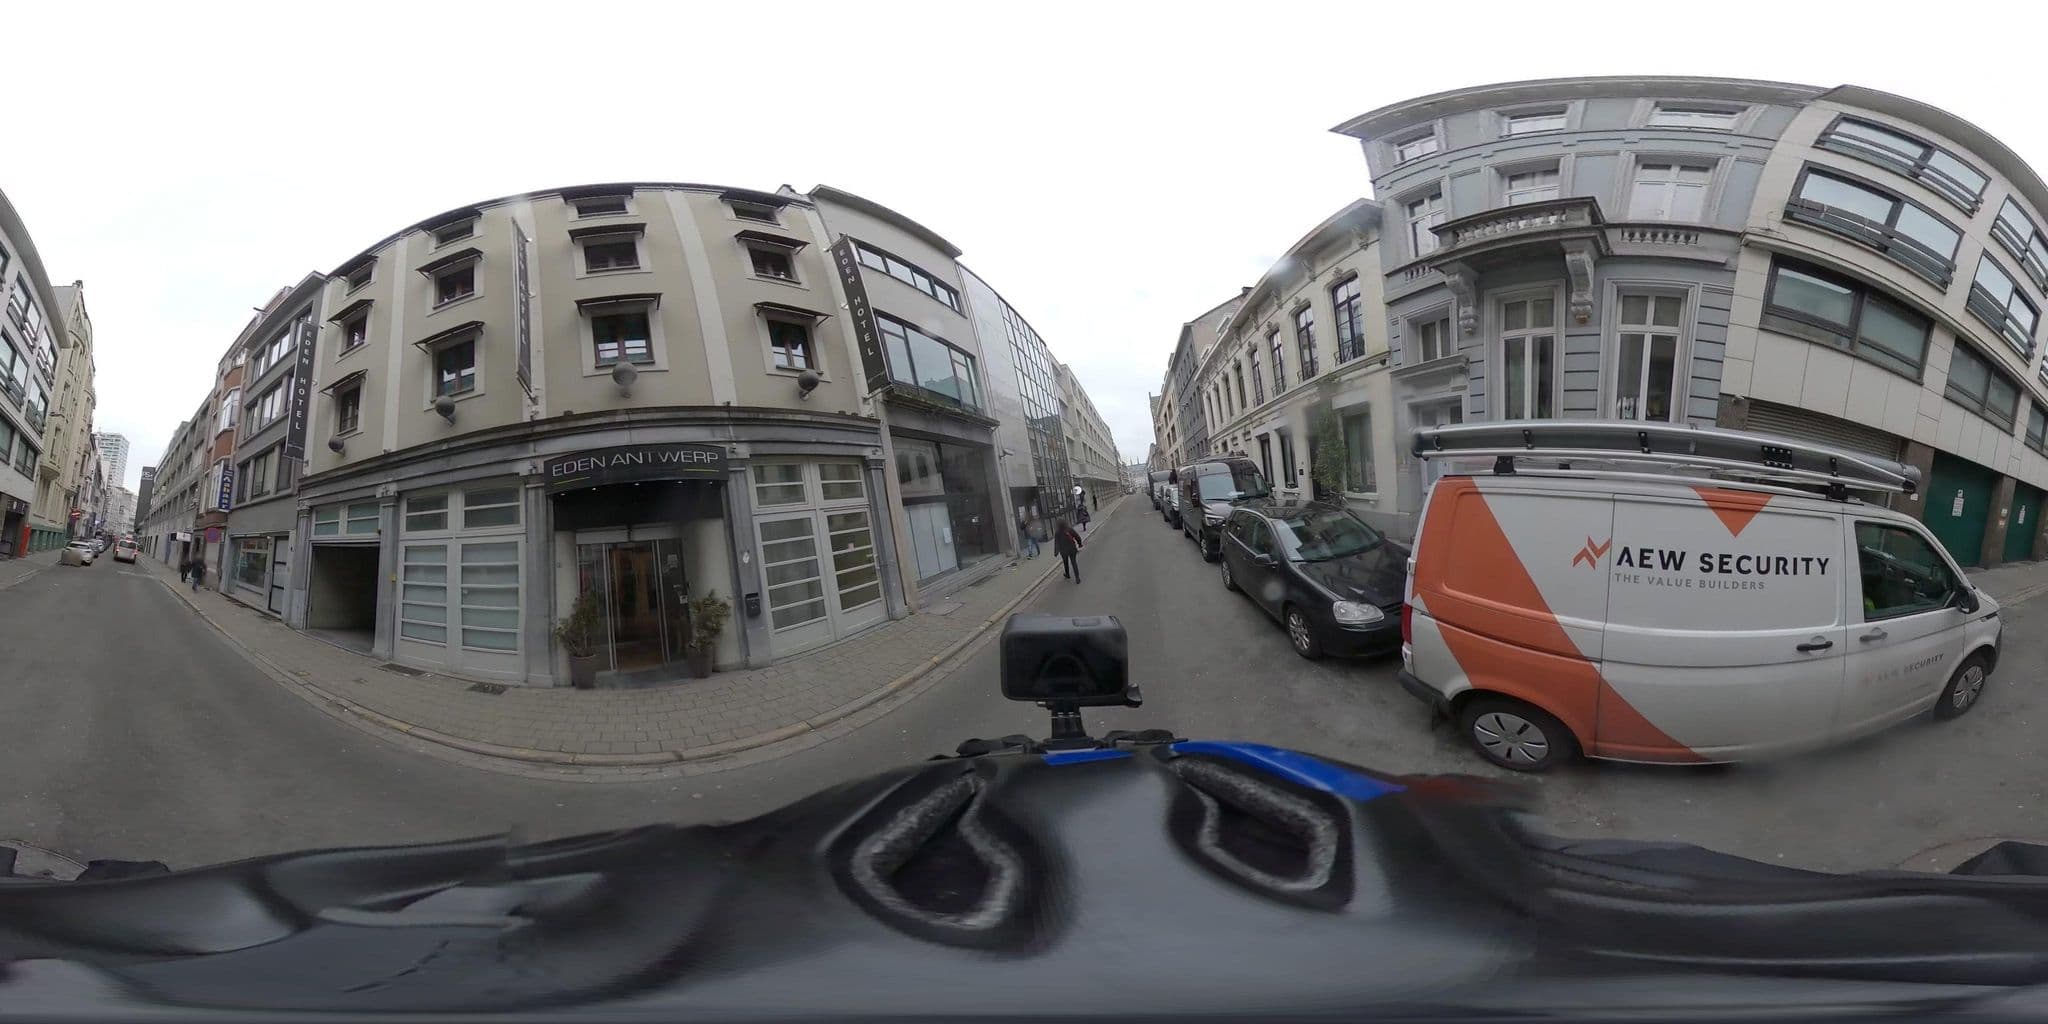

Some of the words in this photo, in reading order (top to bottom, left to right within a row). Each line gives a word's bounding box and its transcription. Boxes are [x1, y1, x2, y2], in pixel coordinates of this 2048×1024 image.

[839, 248, 855, 285] EDEN
[854, 296, 874, 357] HOTEL
[302, 331, 312, 365] EDEN
[295, 377, 307, 430] HOTEL
[552, 456, 606, 477] EDEN
[610, 450, 719, 467] ANTWERP
[1616, 546, 1687, 571] AEW
[1699, 552, 1830, 576] SECURITY
[1615, 573, 1641, 584] THE
[1647, 576, 1692, 588] VALUE
[1699, 579, 1766, 591] BUILDERS
